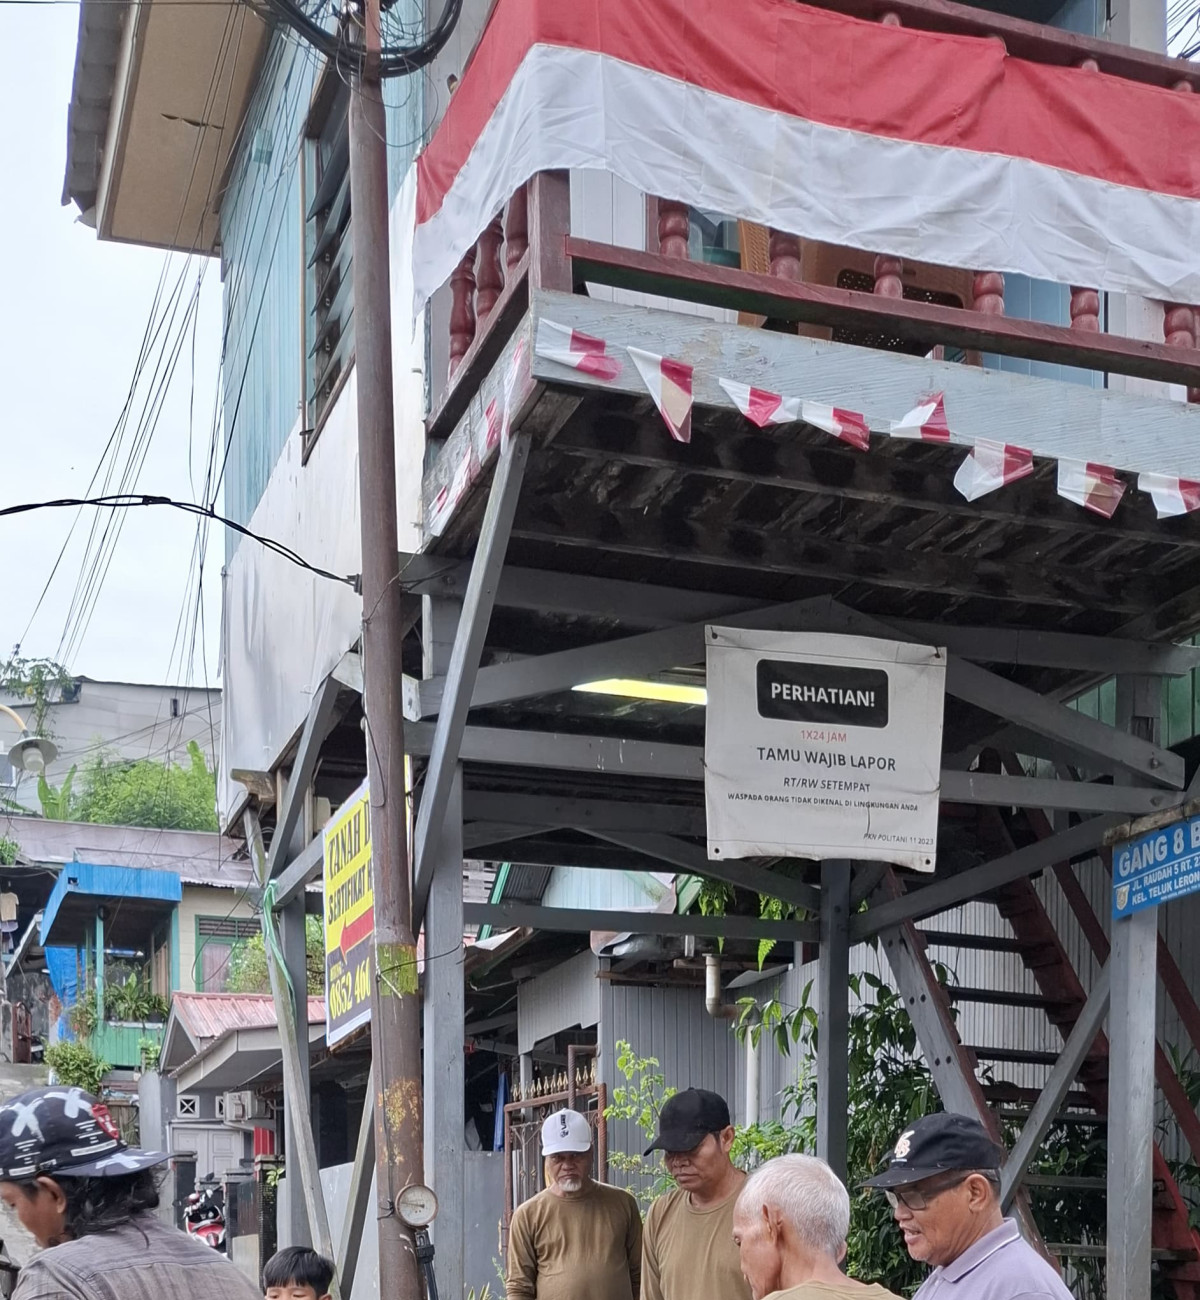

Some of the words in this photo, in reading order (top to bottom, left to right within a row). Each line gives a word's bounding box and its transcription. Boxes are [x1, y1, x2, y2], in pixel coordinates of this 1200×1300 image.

[771, 682, 875, 707] PERHATIAN!
[801, 730, 824, 741] 1X24
[827, 731, 847, 743] JAM
[757, 747, 800, 762] TAMU
[805, 750, 846, 768] WAJIB
[851, 756, 896, 771] LAPOR
[783, 777, 818, 789] RT/RW
[820, 780, 870, 792] SETEMPAT
[728, 793, 763, 801] WASPADA
[764, 795, 789, 803] ORANG
[791, 796, 812, 804] TIDAK
[813, 798, 843, 806] DIKENAL
[854, 801, 899, 810] LINGKUNGAN
[901, 803, 918, 811] ANDA
[328, 810, 361, 880] TANAH
[1119, 835, 1168, 877] GANG
[1173, 828, 1184, 855] 8
[1132, 880, 1142, 891] JL.
[1143, 865, 1172, 887] RAUDAH
[1174, 863, 1179, 875] 5
[1181, 859, 1192, 872] RT.
[1132, 892, 1148, 906] KEL.
[1149, 880, 1173, 899] TELUK
[1174, 870, 1200, 890] LERON
[328, 863, 366, 925] SERTIFIKAT
[330, 971, 353, 1020] 0852
